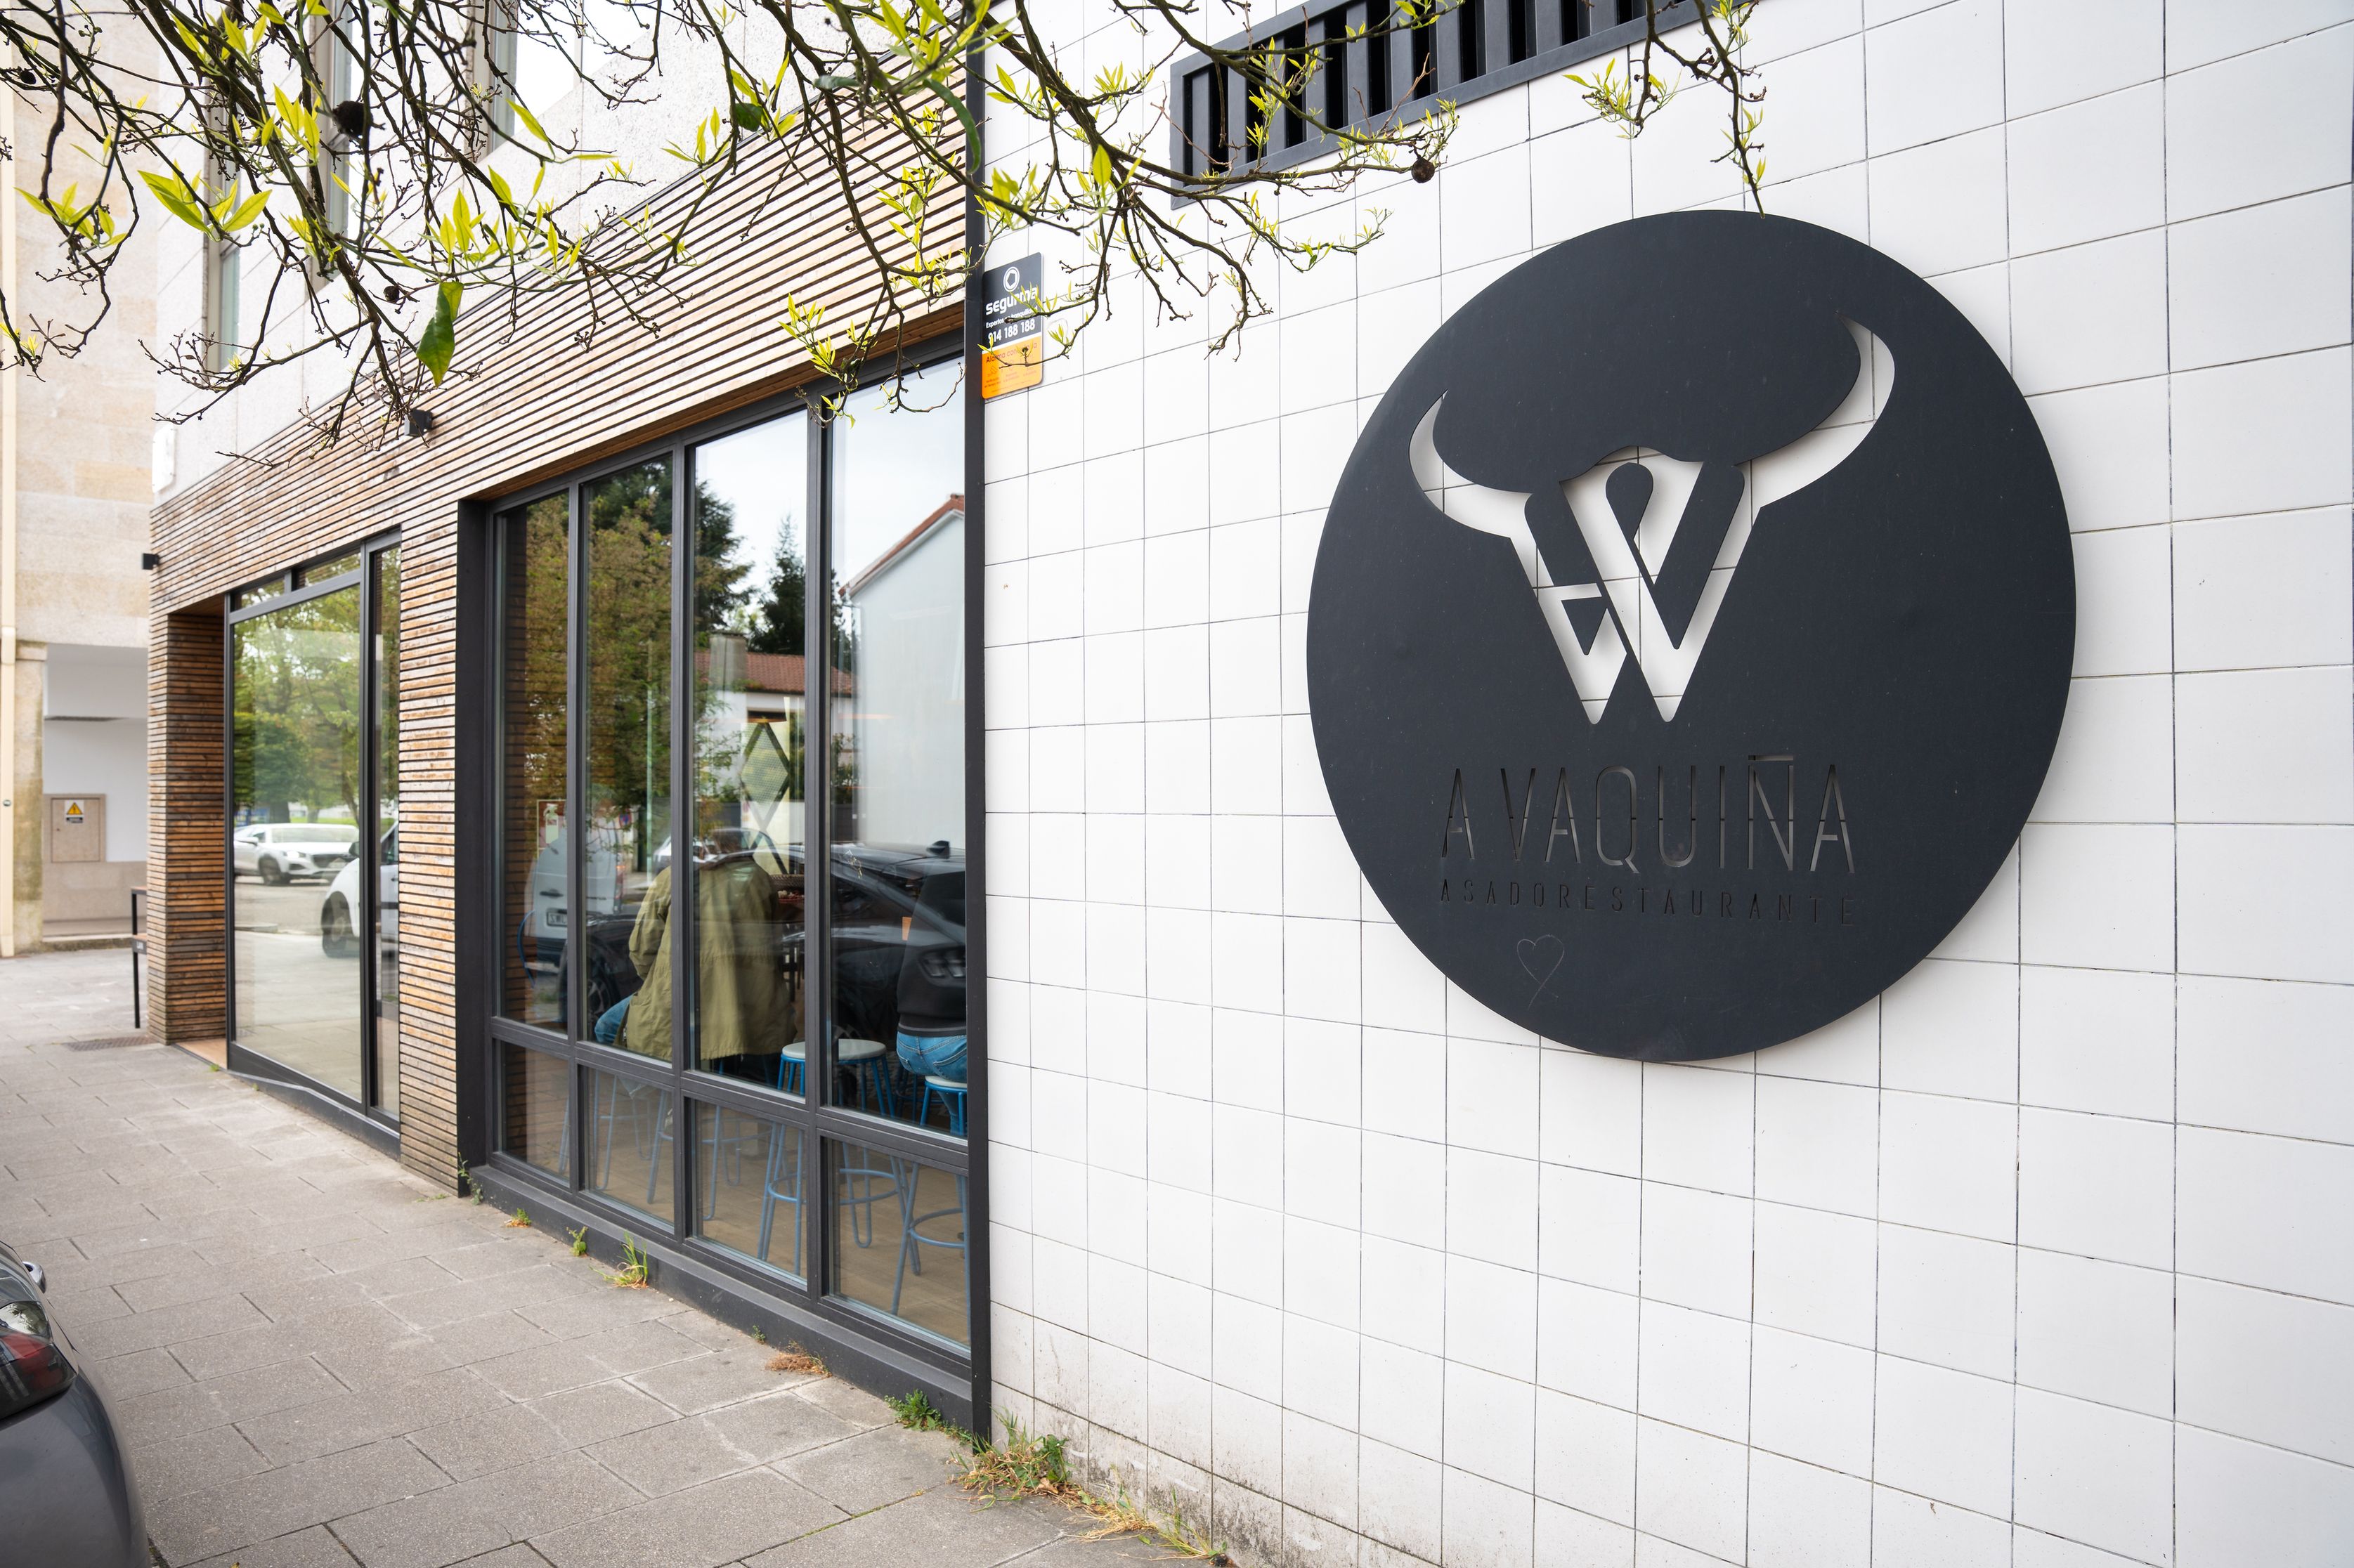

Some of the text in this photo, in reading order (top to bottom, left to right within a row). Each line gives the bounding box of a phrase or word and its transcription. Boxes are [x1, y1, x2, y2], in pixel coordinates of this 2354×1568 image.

[986, 318, 1004, 329] Expertos
[988, 329, 1002, 344] 914
[1004, 324, 1018, 339] 188
[1021, 318, 1036, 333] 188
